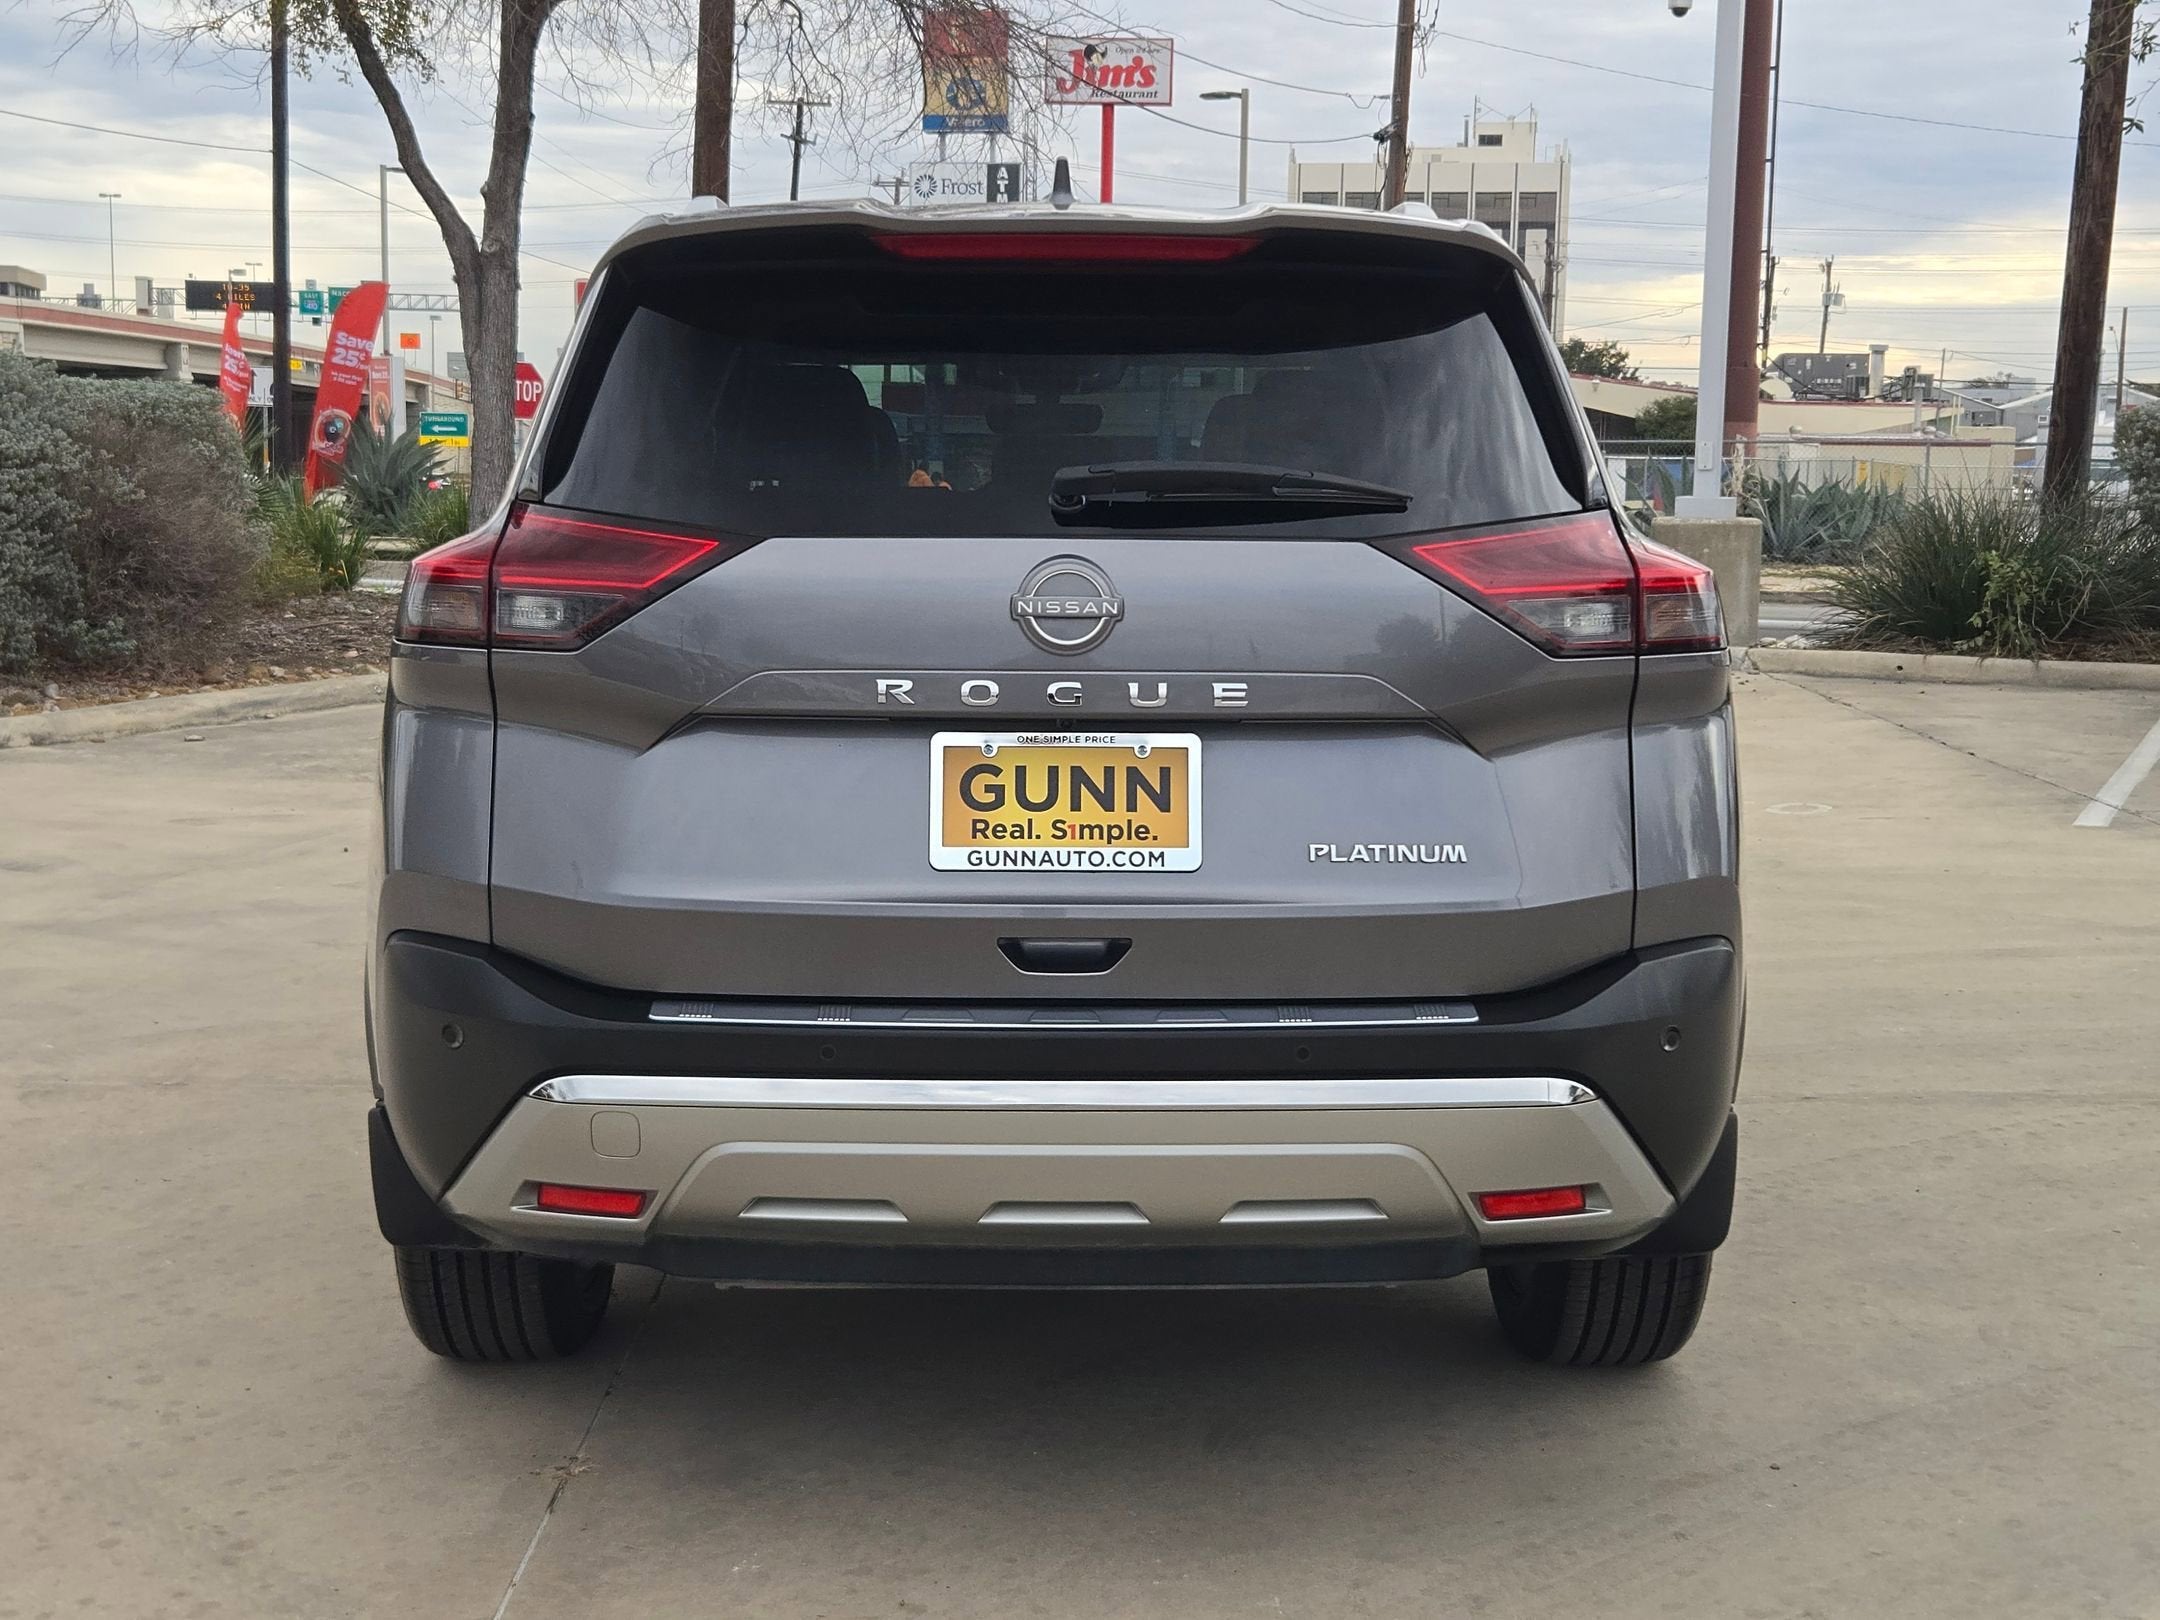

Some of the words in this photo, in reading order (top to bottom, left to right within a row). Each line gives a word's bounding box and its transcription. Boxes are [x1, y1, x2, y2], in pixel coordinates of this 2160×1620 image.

[1091, 88, 1158, 99] Restaurant
[941, 178, 984, 195] Frost
[335, 331, 374, 351] Save
[515, 380, 542, 402] TOP
[1016, 599, 1119, 616] NISSAN
[875, 678, 1250, 708] ROGUE
[1016, 735, 1041, 745] ONE
[1042, 735, 1081, 745] SIMPLE
[1084, 735, 1117, 745] PRICE
[958, 763, 1172, 814] GUNN
[971, 819, 1041, 841] Real.
[967, 849, 1165, 868] GUNNAUTO.COM
[1308, 842, 1468, 864] PLATINUM
